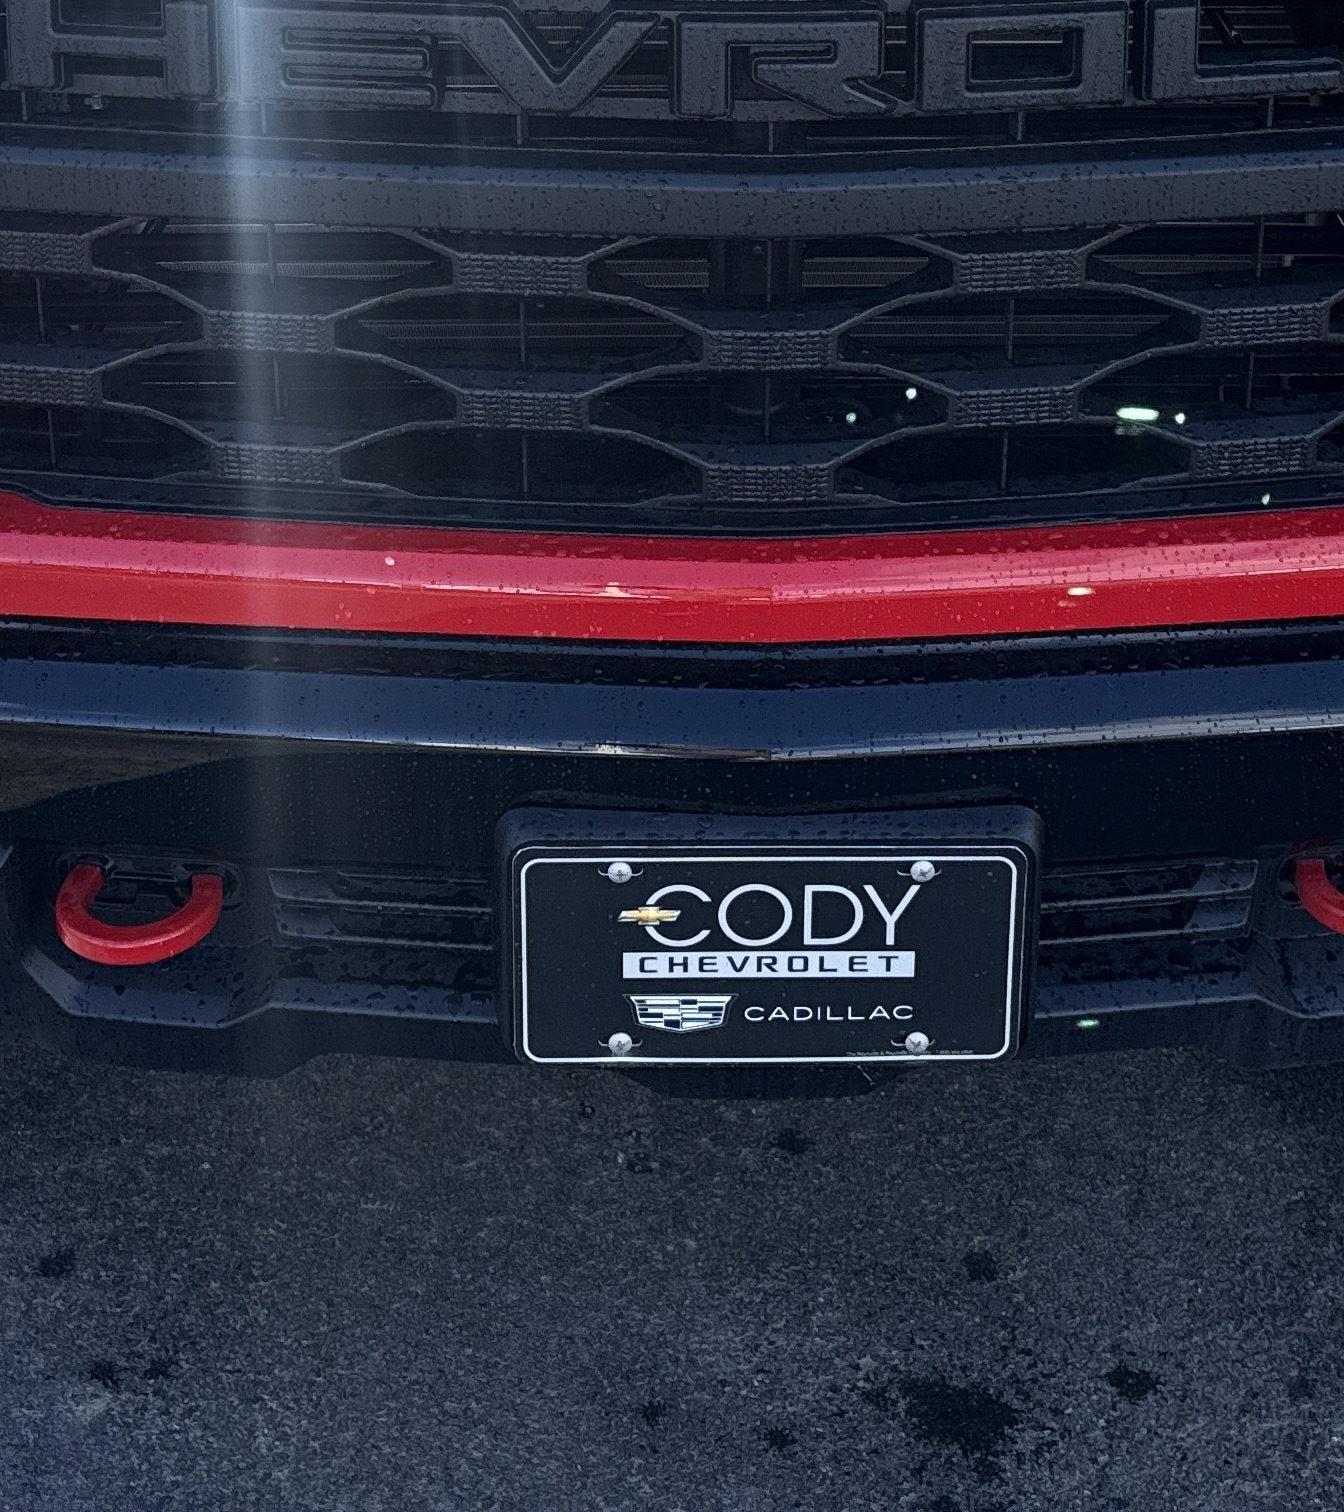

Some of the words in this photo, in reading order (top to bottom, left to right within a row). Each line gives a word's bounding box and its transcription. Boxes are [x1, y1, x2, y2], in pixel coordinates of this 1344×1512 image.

[643, 883, 922, 947] CODY
[638, 954, 899, 974] CHEVROLET
[743, 1005, 914, 1022] CADILLAC
